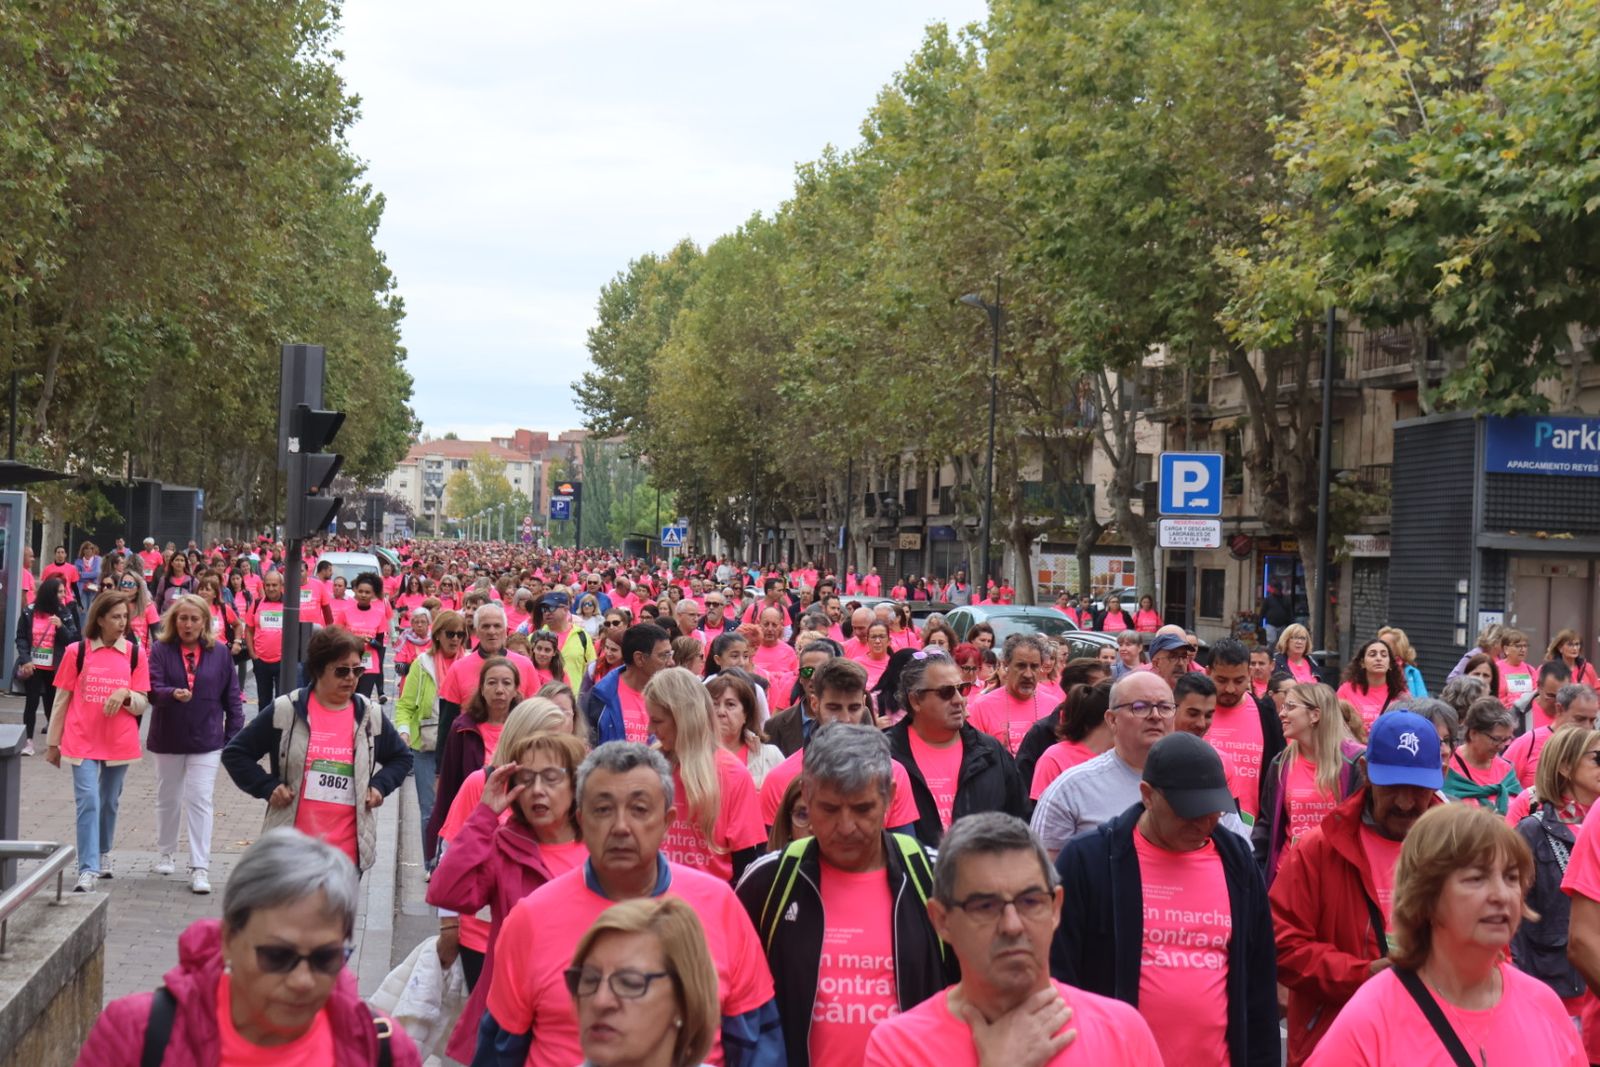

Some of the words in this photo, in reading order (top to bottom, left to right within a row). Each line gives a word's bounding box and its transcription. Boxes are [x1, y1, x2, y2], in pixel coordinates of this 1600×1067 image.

[1507, 460, 1571, 471] APARCAMIENTO
[1571, 463, 1599, 473] REYES
[1172, 460, 1210, 508] P
[319, 773, 349, 790] 3862
[1165, 906, 1232, 928] marcha
